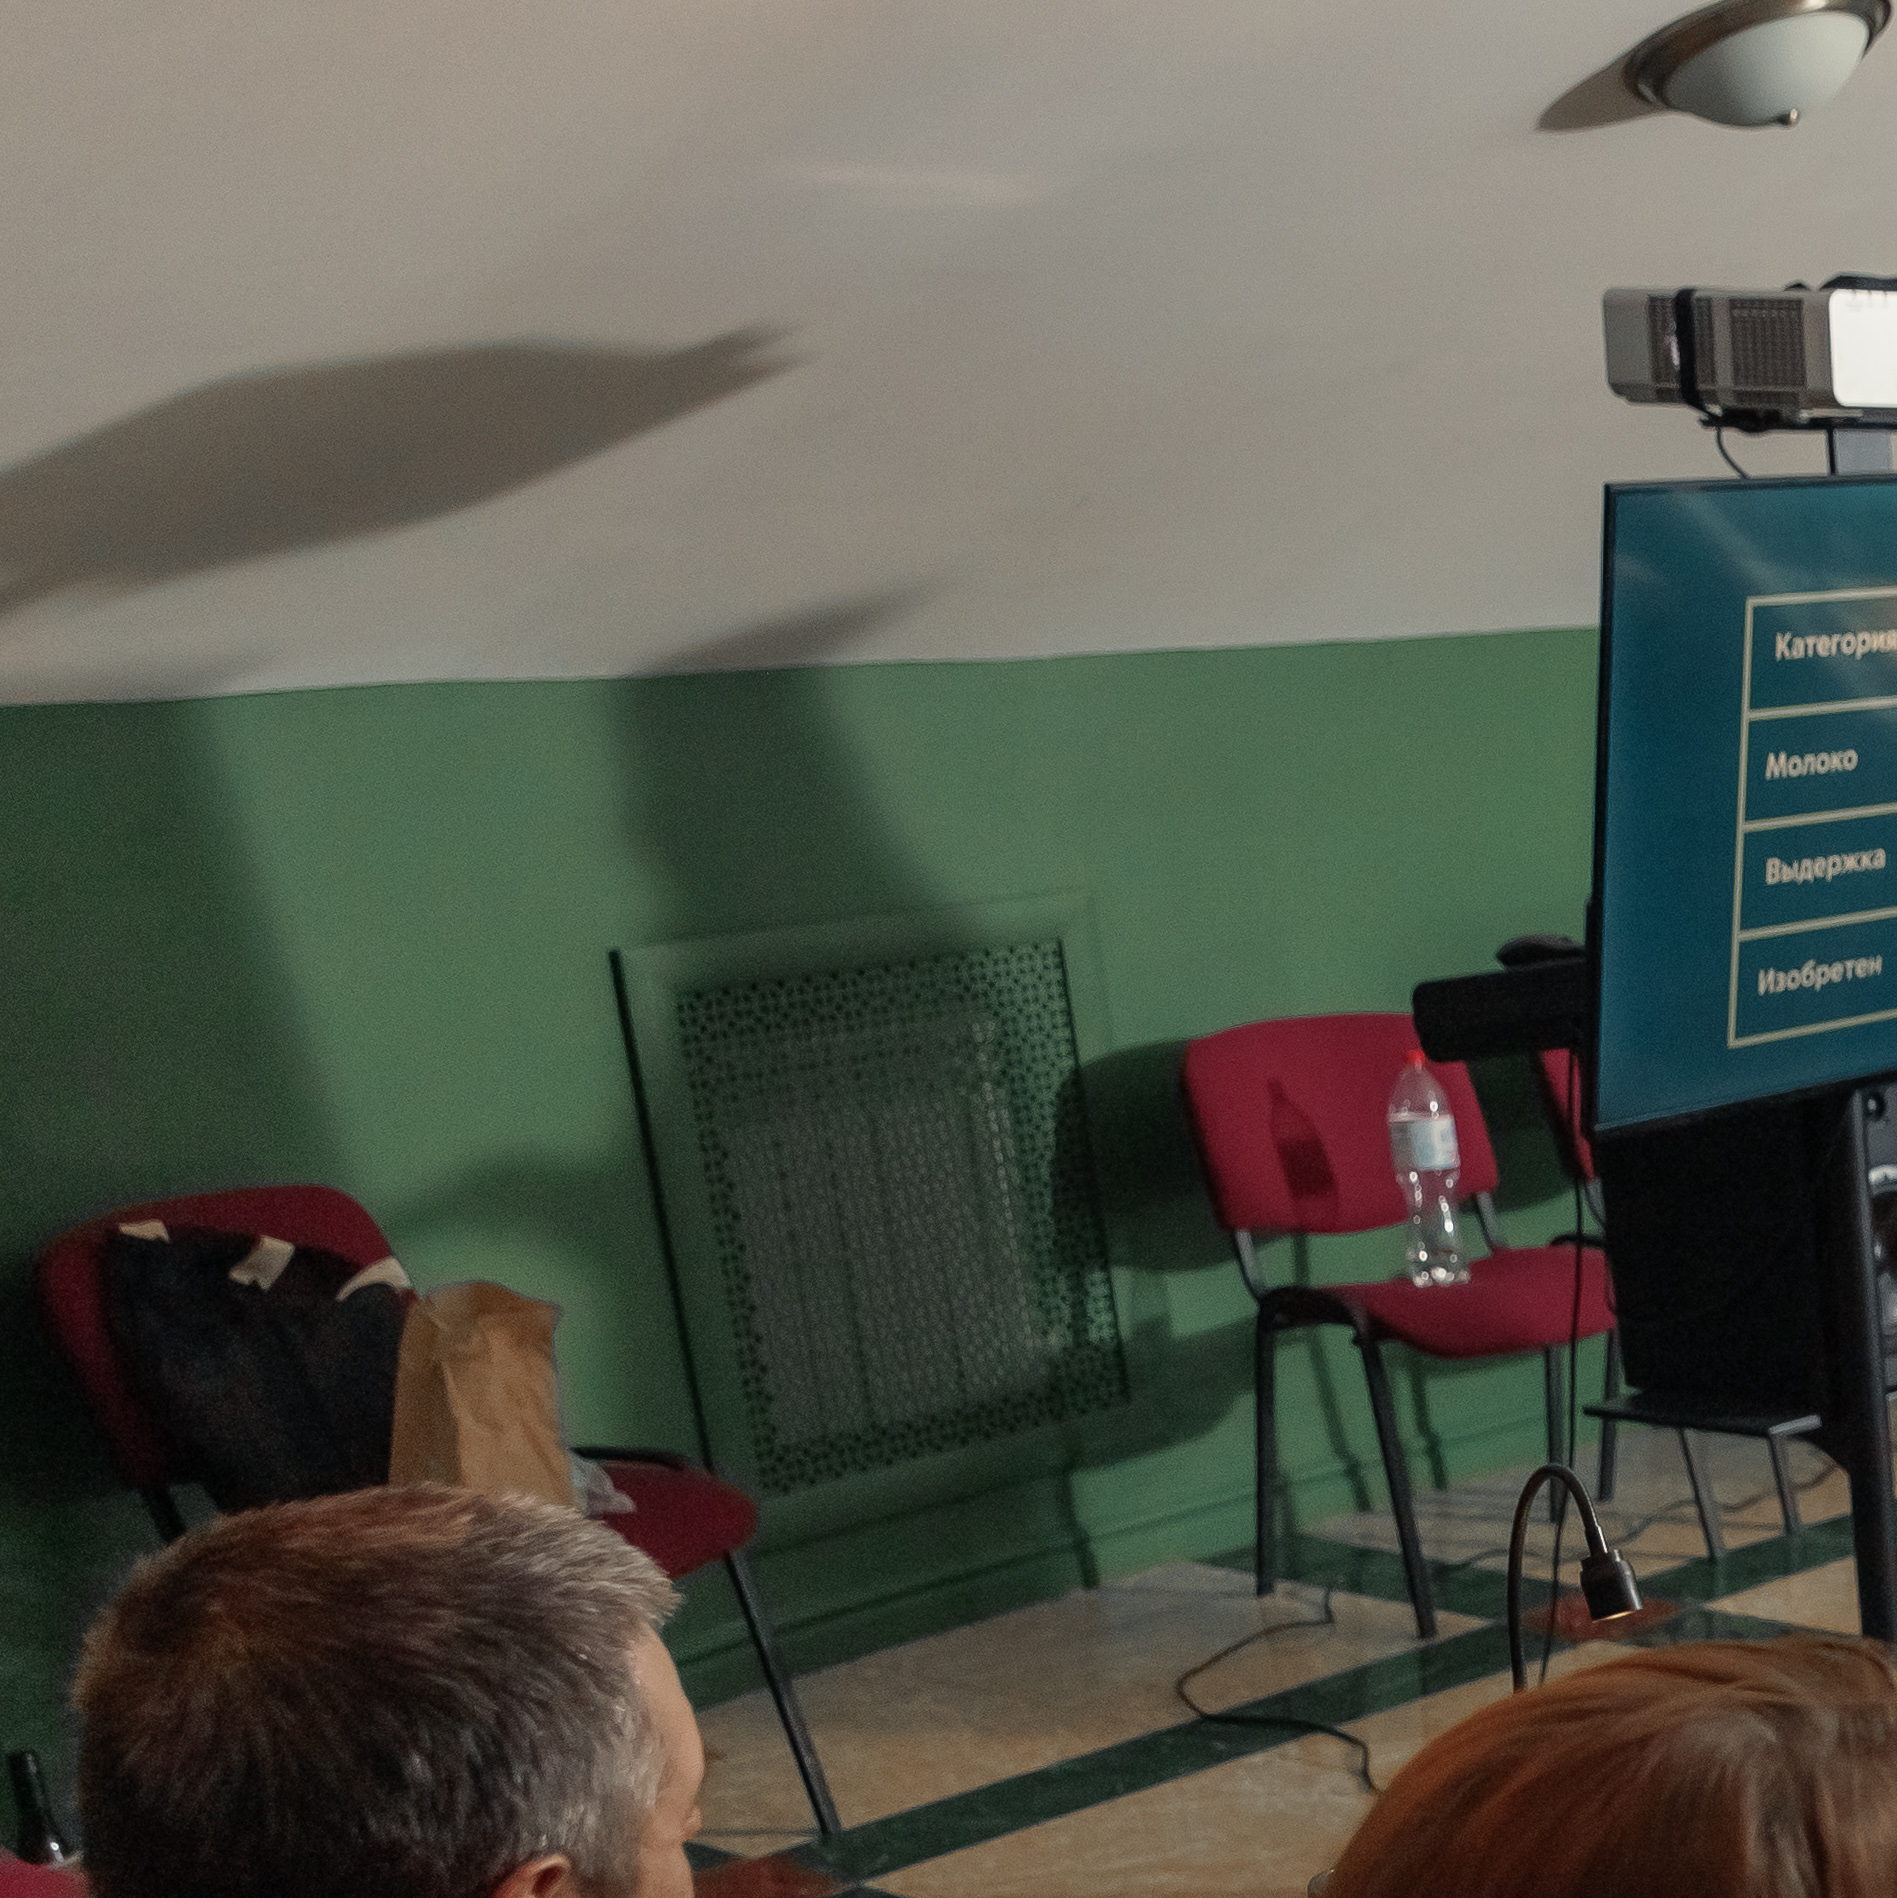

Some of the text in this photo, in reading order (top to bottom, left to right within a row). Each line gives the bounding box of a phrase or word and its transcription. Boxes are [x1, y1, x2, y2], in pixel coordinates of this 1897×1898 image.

[1765, 749, 1859, 780] Молоко
[1764, 848, 1887, 886] Выдержка
[1757, 954, 1883, 996] Изобретен
